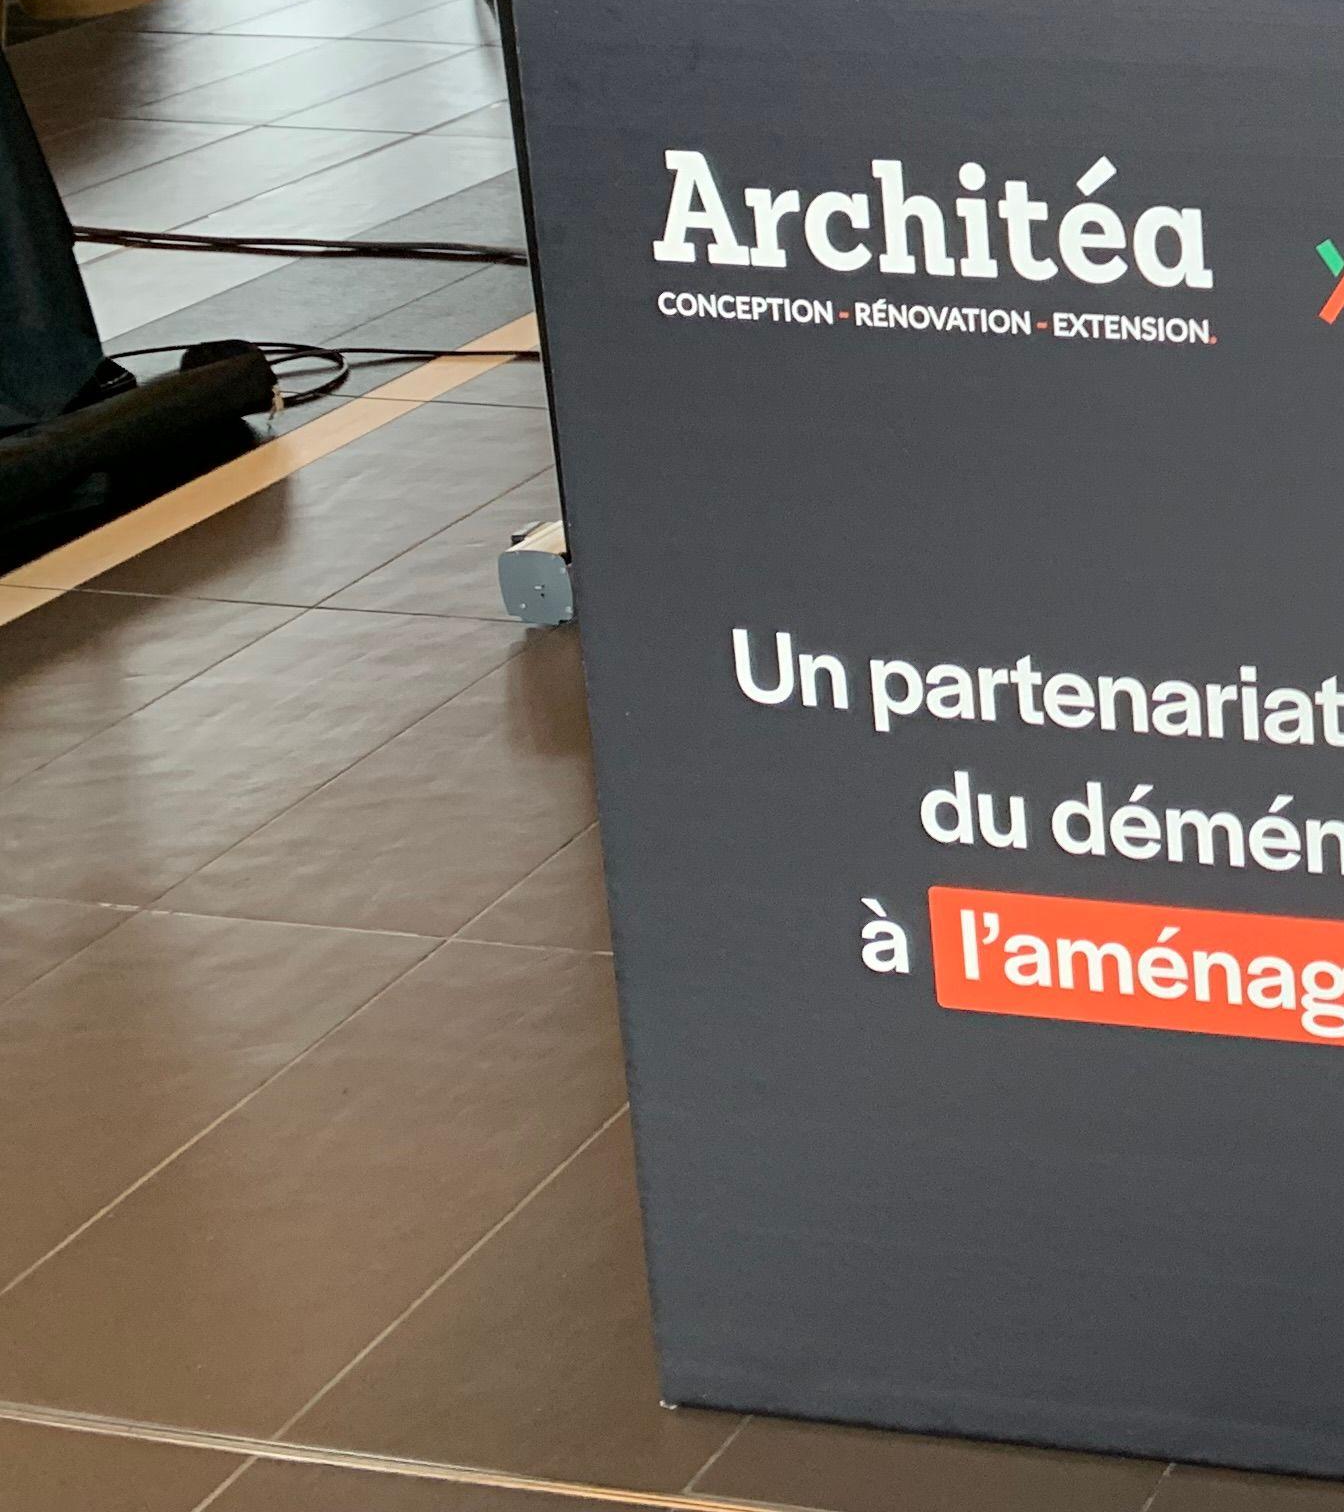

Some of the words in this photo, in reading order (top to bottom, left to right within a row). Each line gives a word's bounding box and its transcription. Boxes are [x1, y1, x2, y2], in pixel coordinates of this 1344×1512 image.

[651, 149, 1214, 290] Architéa
[657, 291, 835, 326] CONCEPTION
[854, 293, 1033, 337] RÉNOVATION
[1052, 312, 1217, 345] EXTENSION.
[732, 626, 850, 710] Un
[919, 770, 1029, 849] du
[860, 900, 911, 975] à
